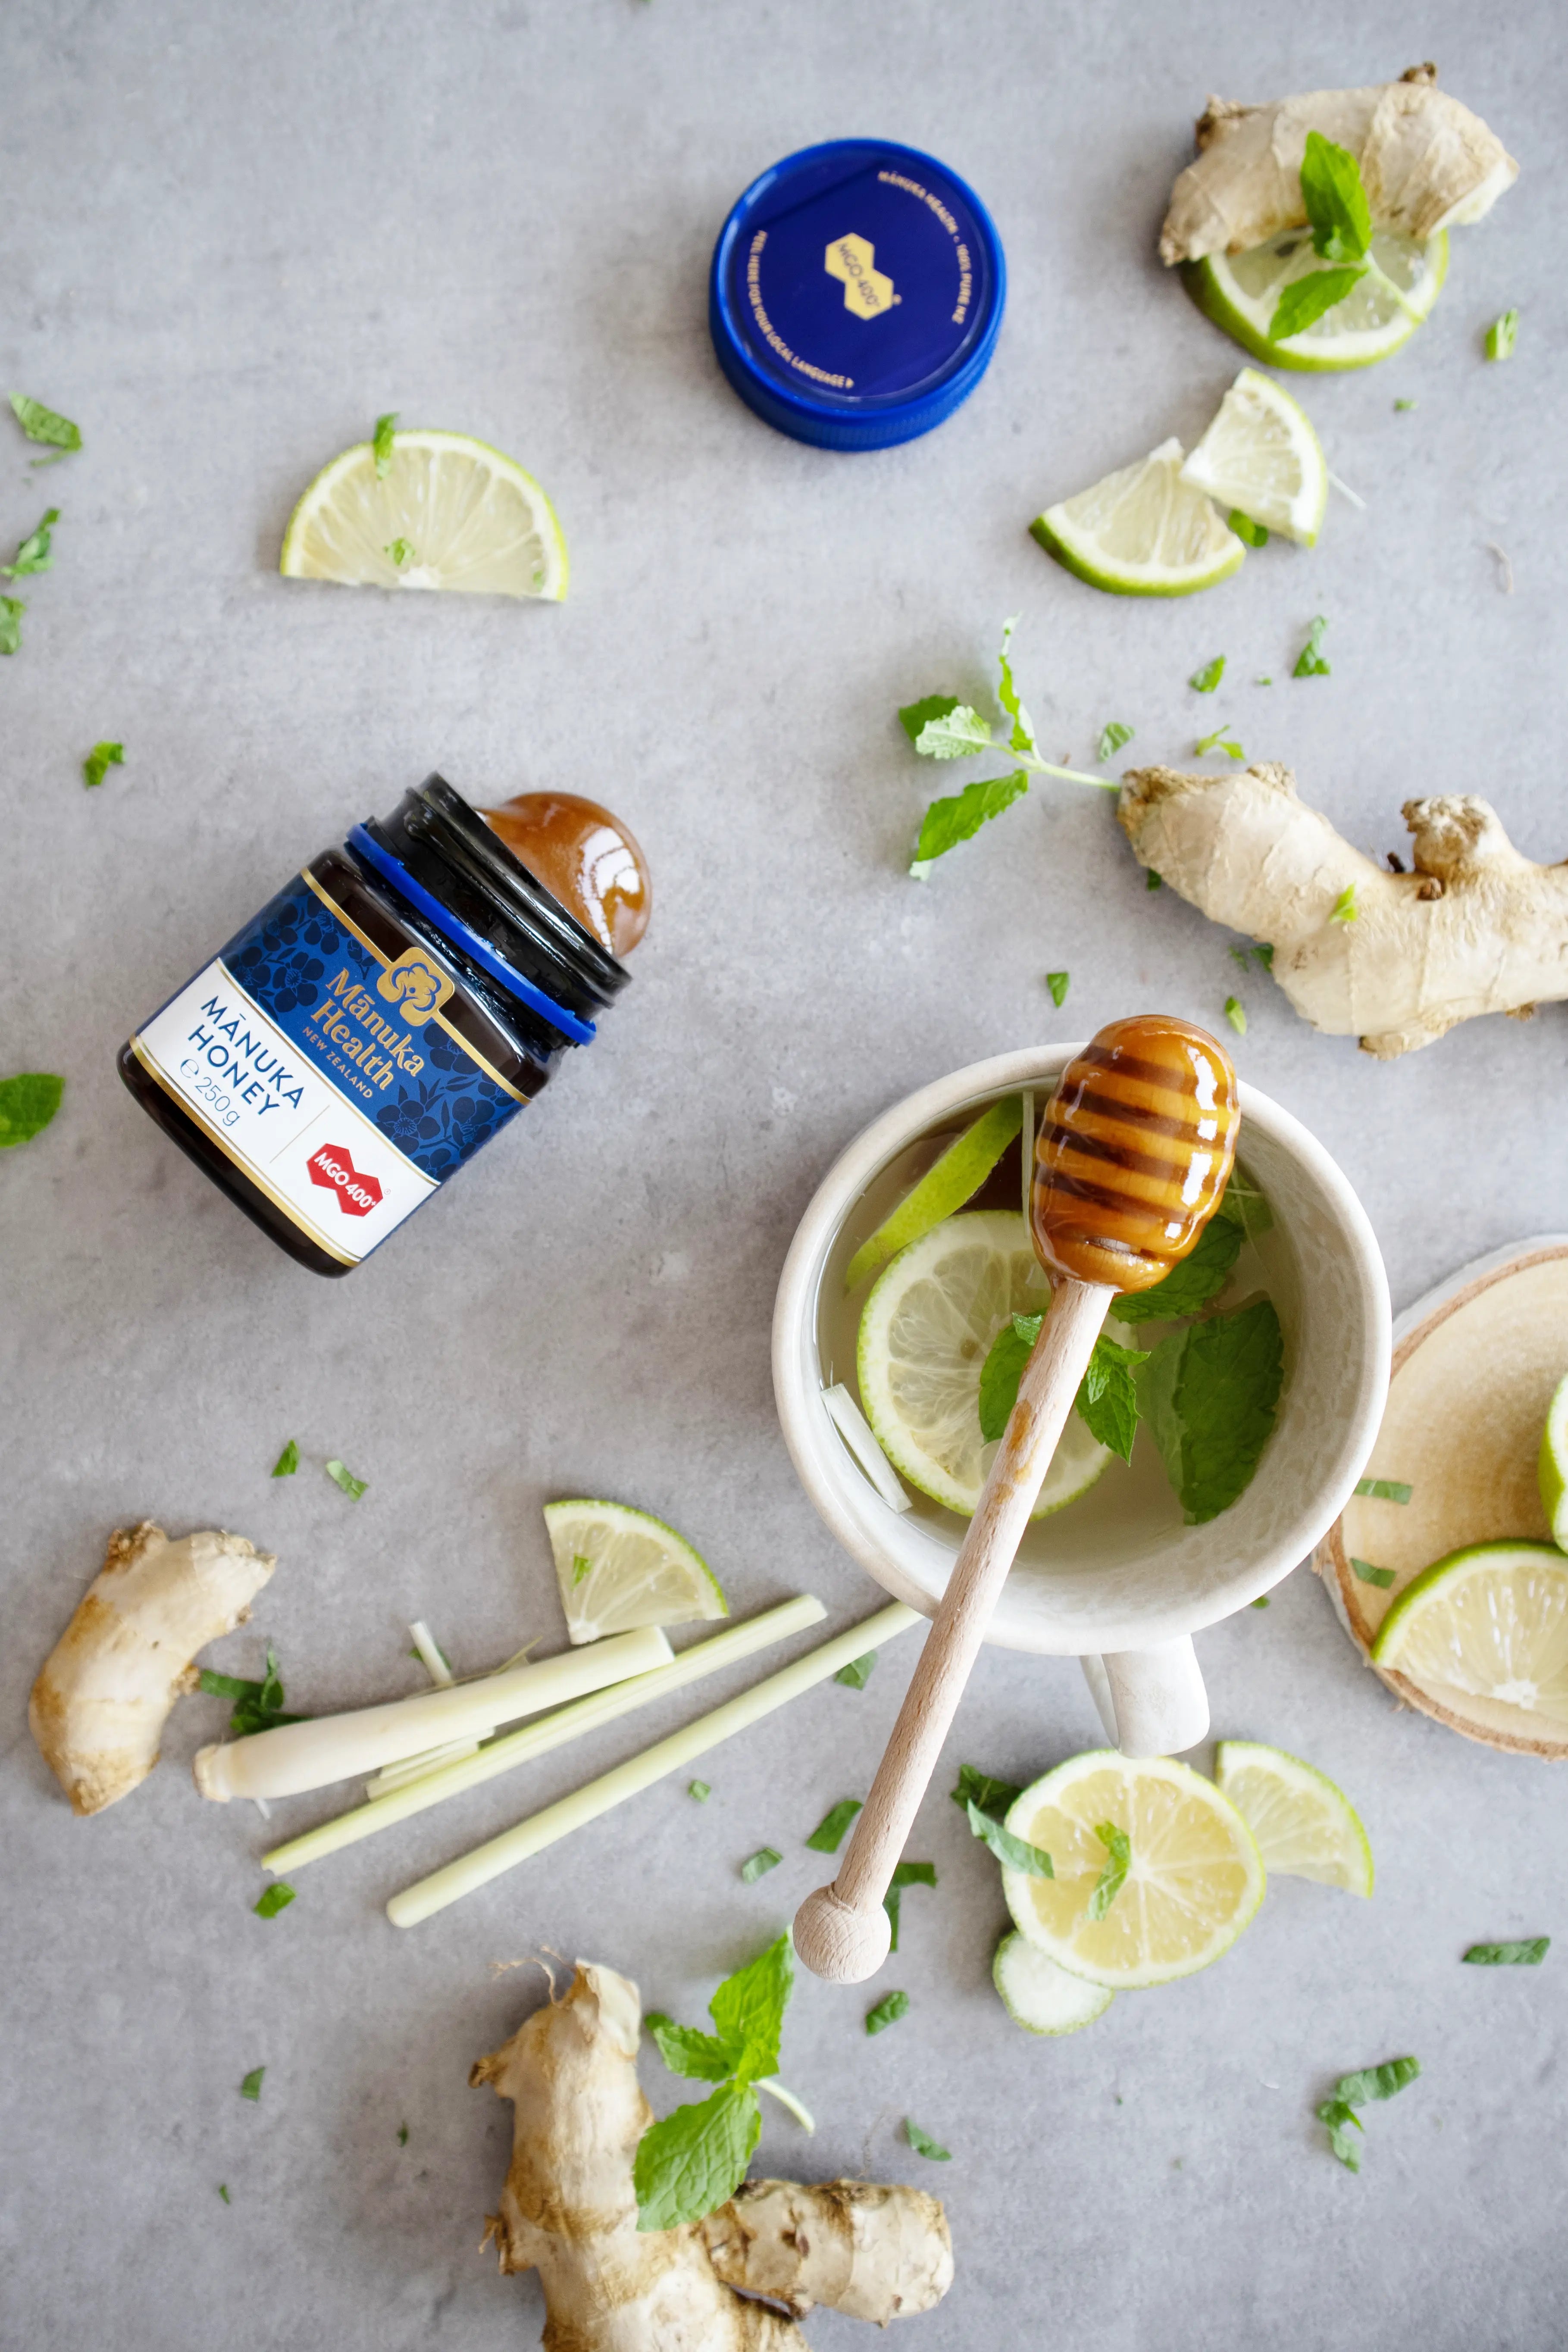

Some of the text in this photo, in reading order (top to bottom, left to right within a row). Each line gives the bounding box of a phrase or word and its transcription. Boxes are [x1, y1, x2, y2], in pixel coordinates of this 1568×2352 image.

[838, 243, 863, 278] MGO
[748, 283, 762, 307] FOR
[754, 305, 773, 335] YOUR
[766, 331, 793, 362] LOCAL
[310, 998, 394, 1091] Health
[325, 967, 424, 1077] Mānuka
[188, 1024, 280, 1115] HONEY
[200, 995, 304, 1109] MĀNUKA
[302, 1026, 372, 1098] NEW ZEALAND
[194, 1077, 240, 1126] 250g
[314, 1152, 376, 1208] MGO 400+
